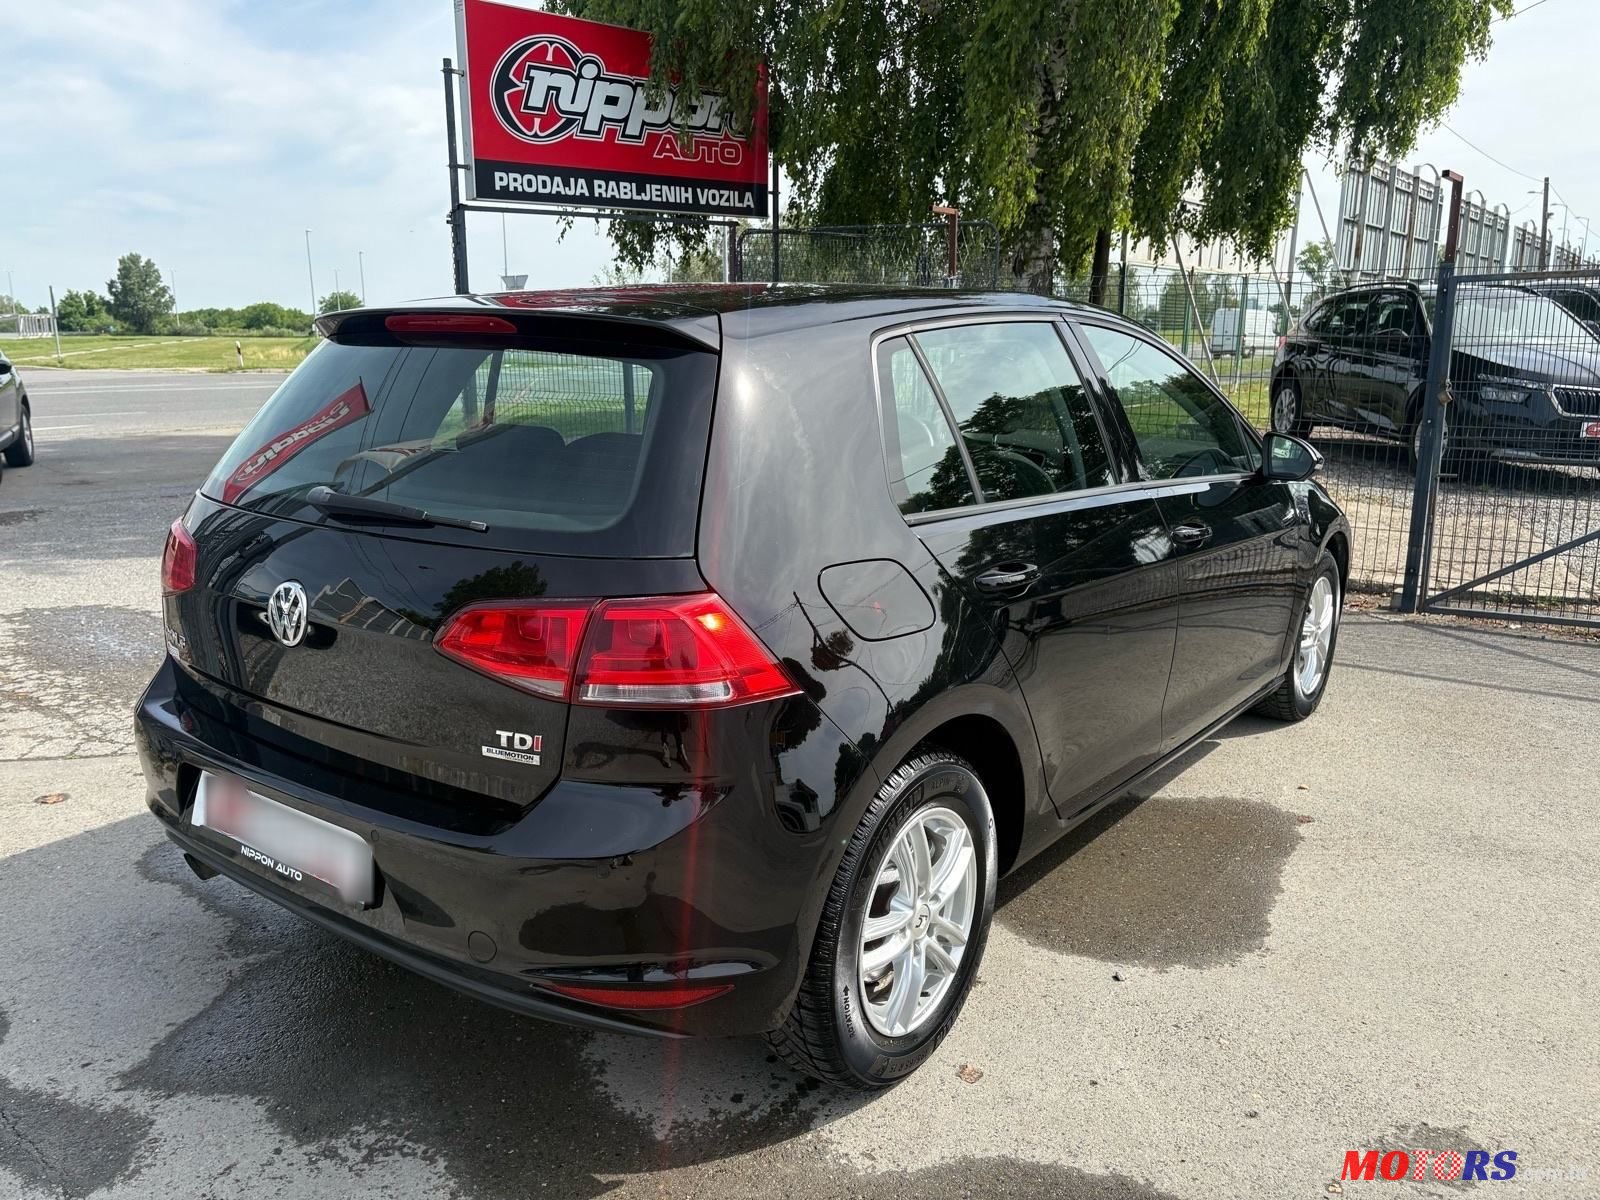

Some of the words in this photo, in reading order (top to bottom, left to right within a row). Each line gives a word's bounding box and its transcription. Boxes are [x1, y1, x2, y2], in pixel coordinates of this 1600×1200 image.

[653, 133, 743, 166] AUTO
[494, 170, 589, 198] PRODAJA
[594, 180, 693, 205] RABLJENIH
[698, 188, 755, 209] VOZILA
[486, 747, 535, 761] BLUEMOTION
[495, 729, 542, 752] TDI
[240, 845, 274, 869] NIPPON
[275, 862, 303, 882] AUTO
